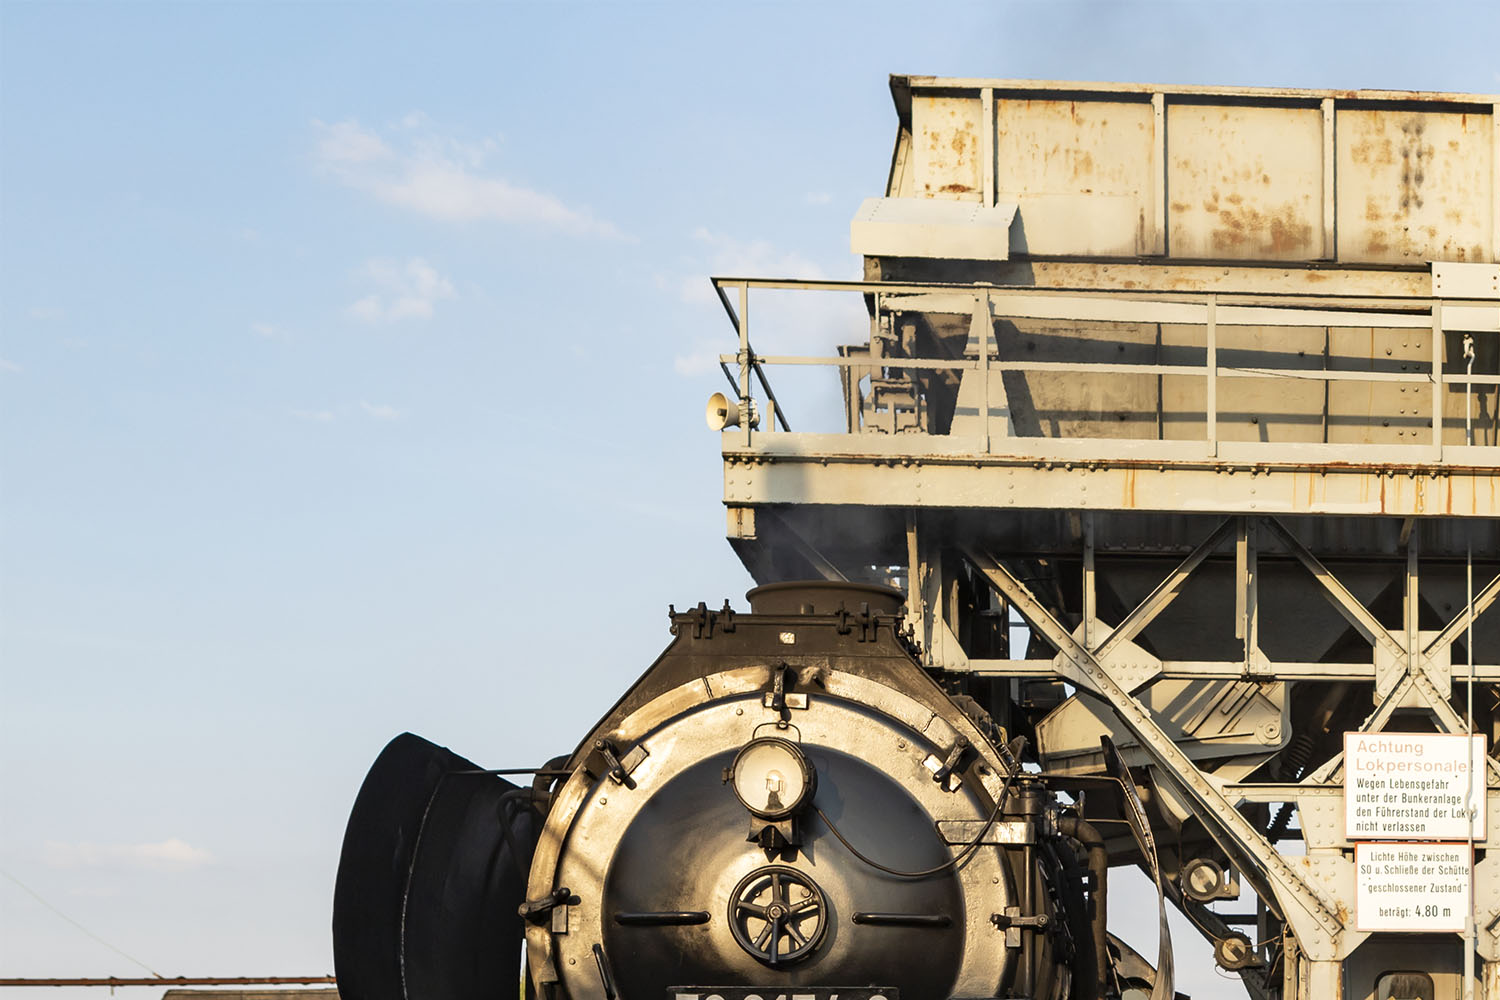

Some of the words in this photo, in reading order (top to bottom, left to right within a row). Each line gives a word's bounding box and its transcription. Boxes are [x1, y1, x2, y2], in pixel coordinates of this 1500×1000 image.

[1356, 740, 1424, 756] Achtung
[1357, 778, 1386, 790] Wegen
[1389, 779, 1449, 791] Lebensgefahr
[1356, 794, 1379, 803] unter
[1383, 793, 1398, 803] der
[1401, 793, 1462, 806] Bunkeranlage
[1356, 807, 1372, 817] den
[1375, 807, 1430, 818] Führerstand
[1433, 808, 1447, 818] der
[1356, 821, 1378, 832] nicht
[1382, 821, 1426, 832] verlassen
[1370, 852, 1395, 862] Lichte
[1398, 852, 1418, 862] Höhe
[1421, 852, 1460, 862] zwischen
[1384, 865, 1419, 875] Schließe
[1421, 865, 1435, 875] der
[1438, 865, 1470, 876] Schütte
[1379, 907, 1412, 918] beträgt:
[1415, 905, 1438, 918] 4.80
[1442, 907, 1451, 917] m
